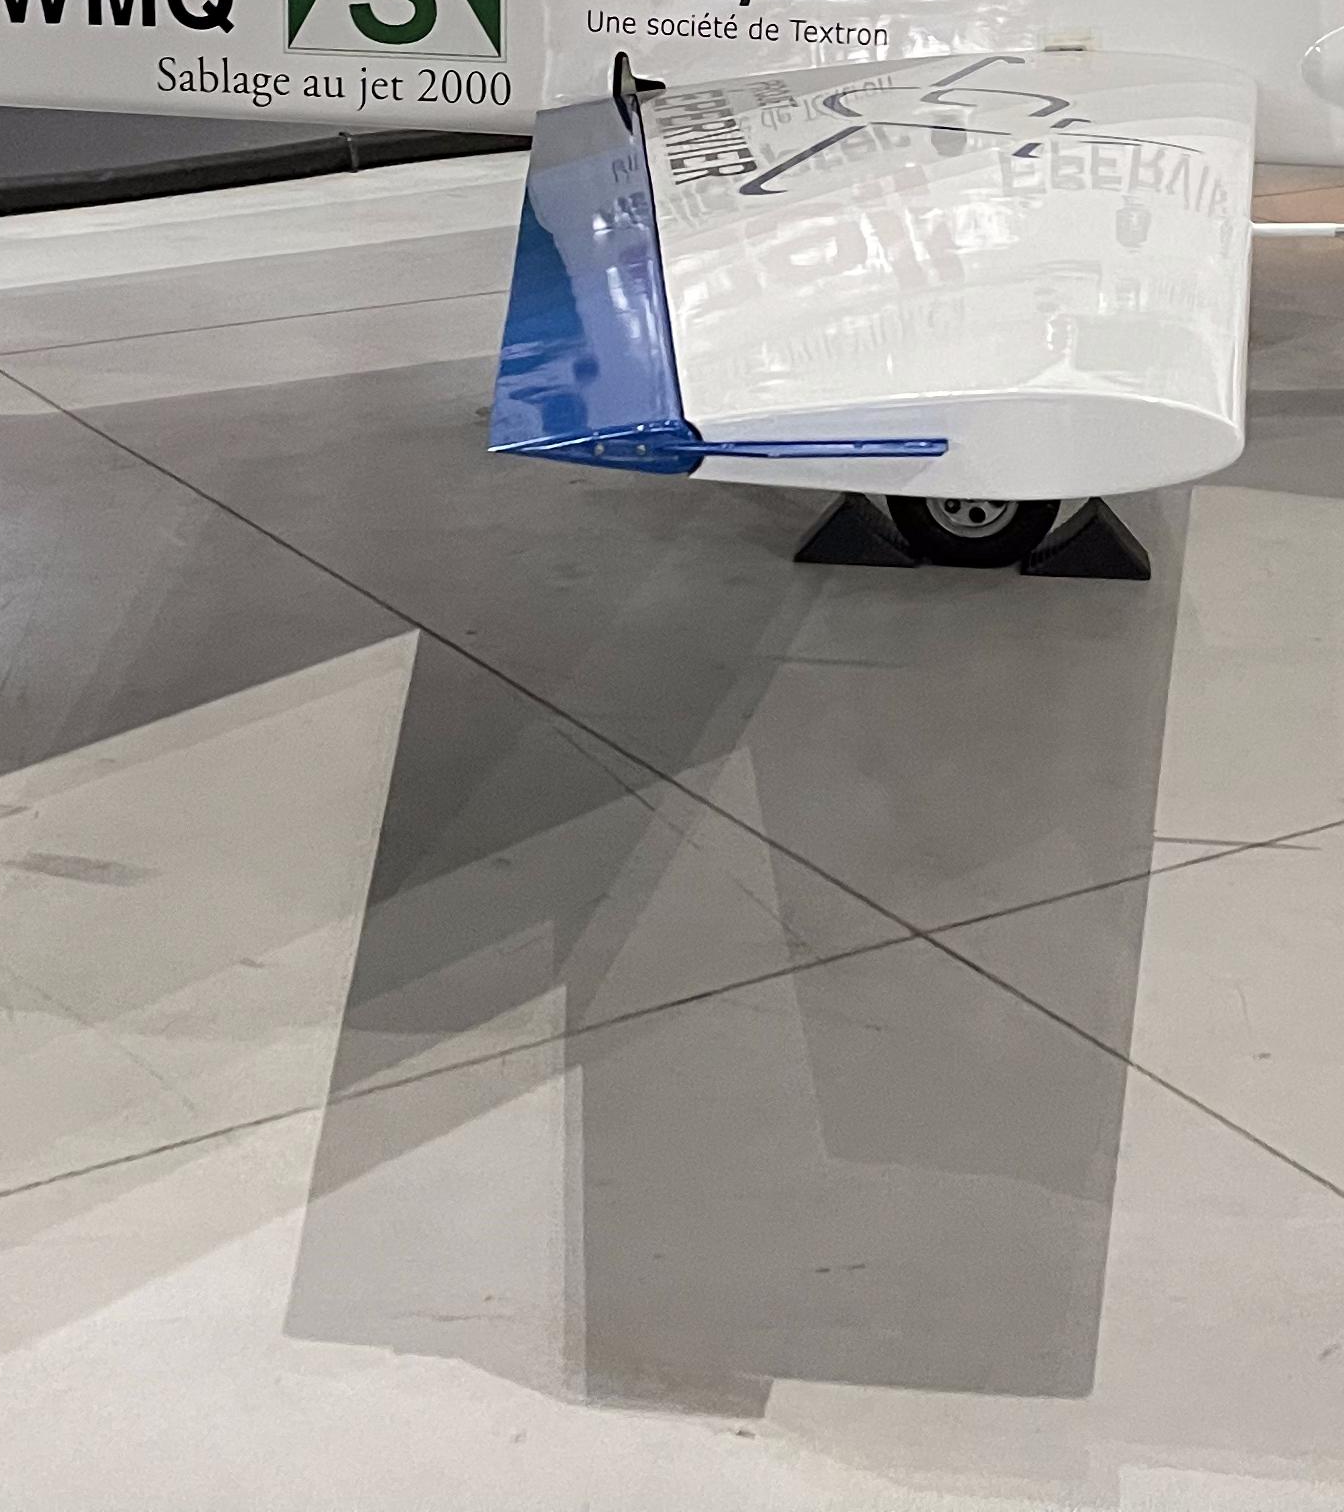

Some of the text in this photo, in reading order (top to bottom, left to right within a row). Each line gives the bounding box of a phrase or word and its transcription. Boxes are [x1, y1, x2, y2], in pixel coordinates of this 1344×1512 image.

[587, 10, 888, 46] Une société de Textron
[157, 56, 512, 112] Sablage au jet 2000
